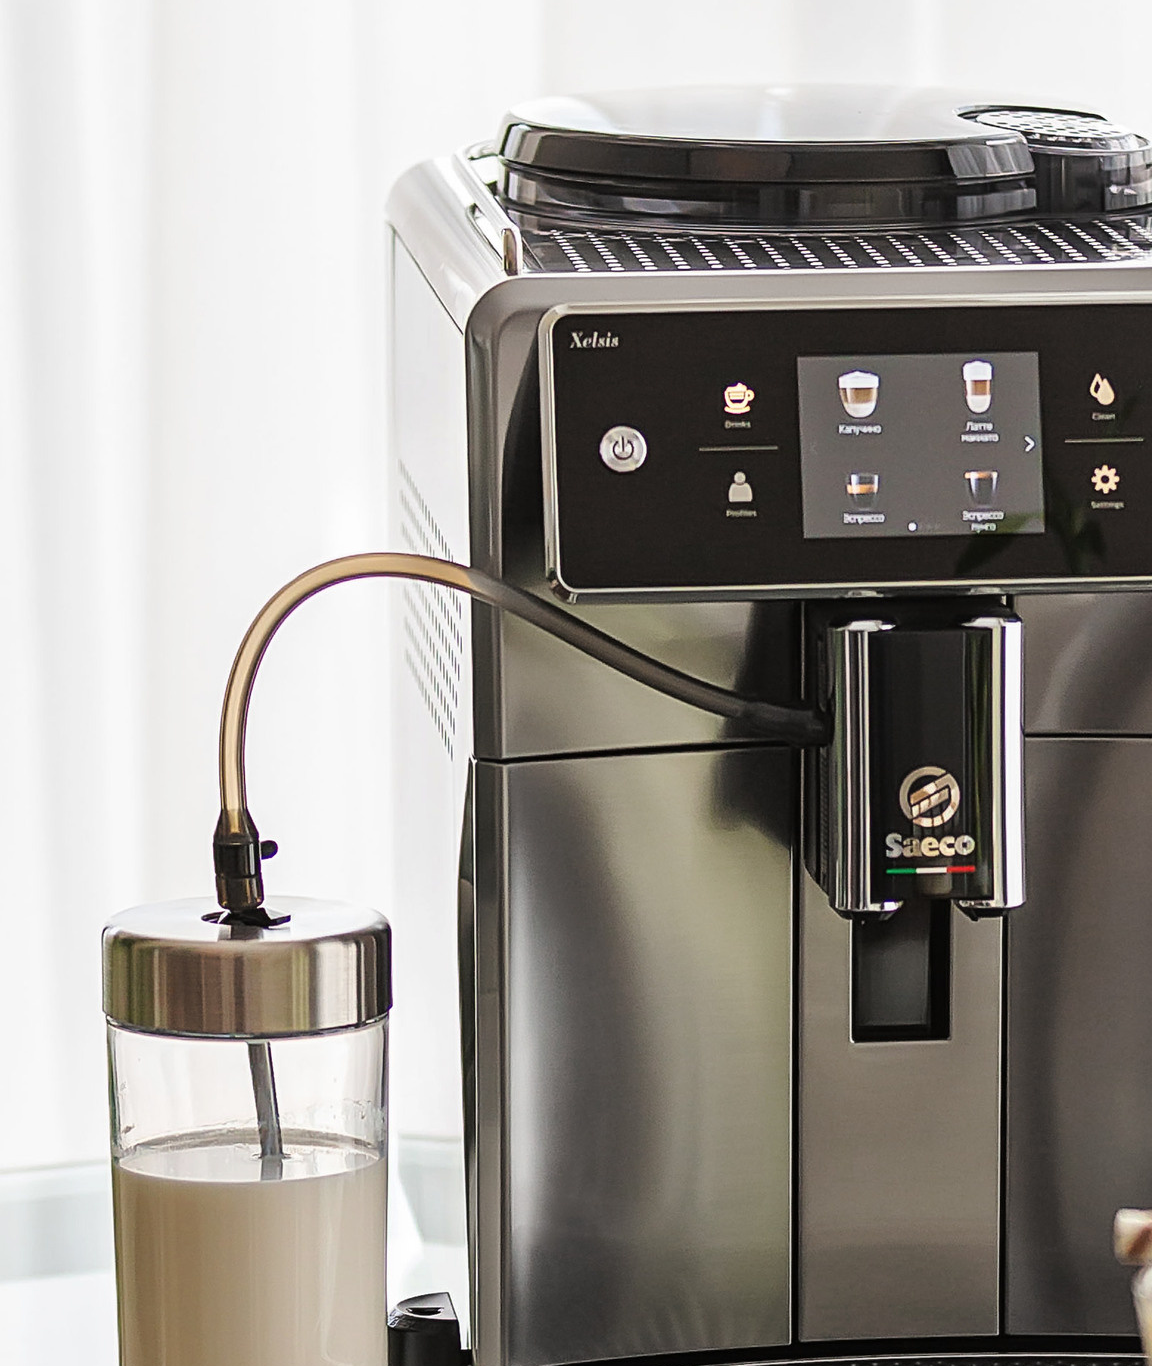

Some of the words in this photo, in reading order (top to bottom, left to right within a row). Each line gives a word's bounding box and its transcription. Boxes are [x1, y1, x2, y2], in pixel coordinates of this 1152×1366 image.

[570, 331, 619, 348] Xelsis
[838, 424, 881, 435] Капучино
[885, 833, 976, 858] Saeco
